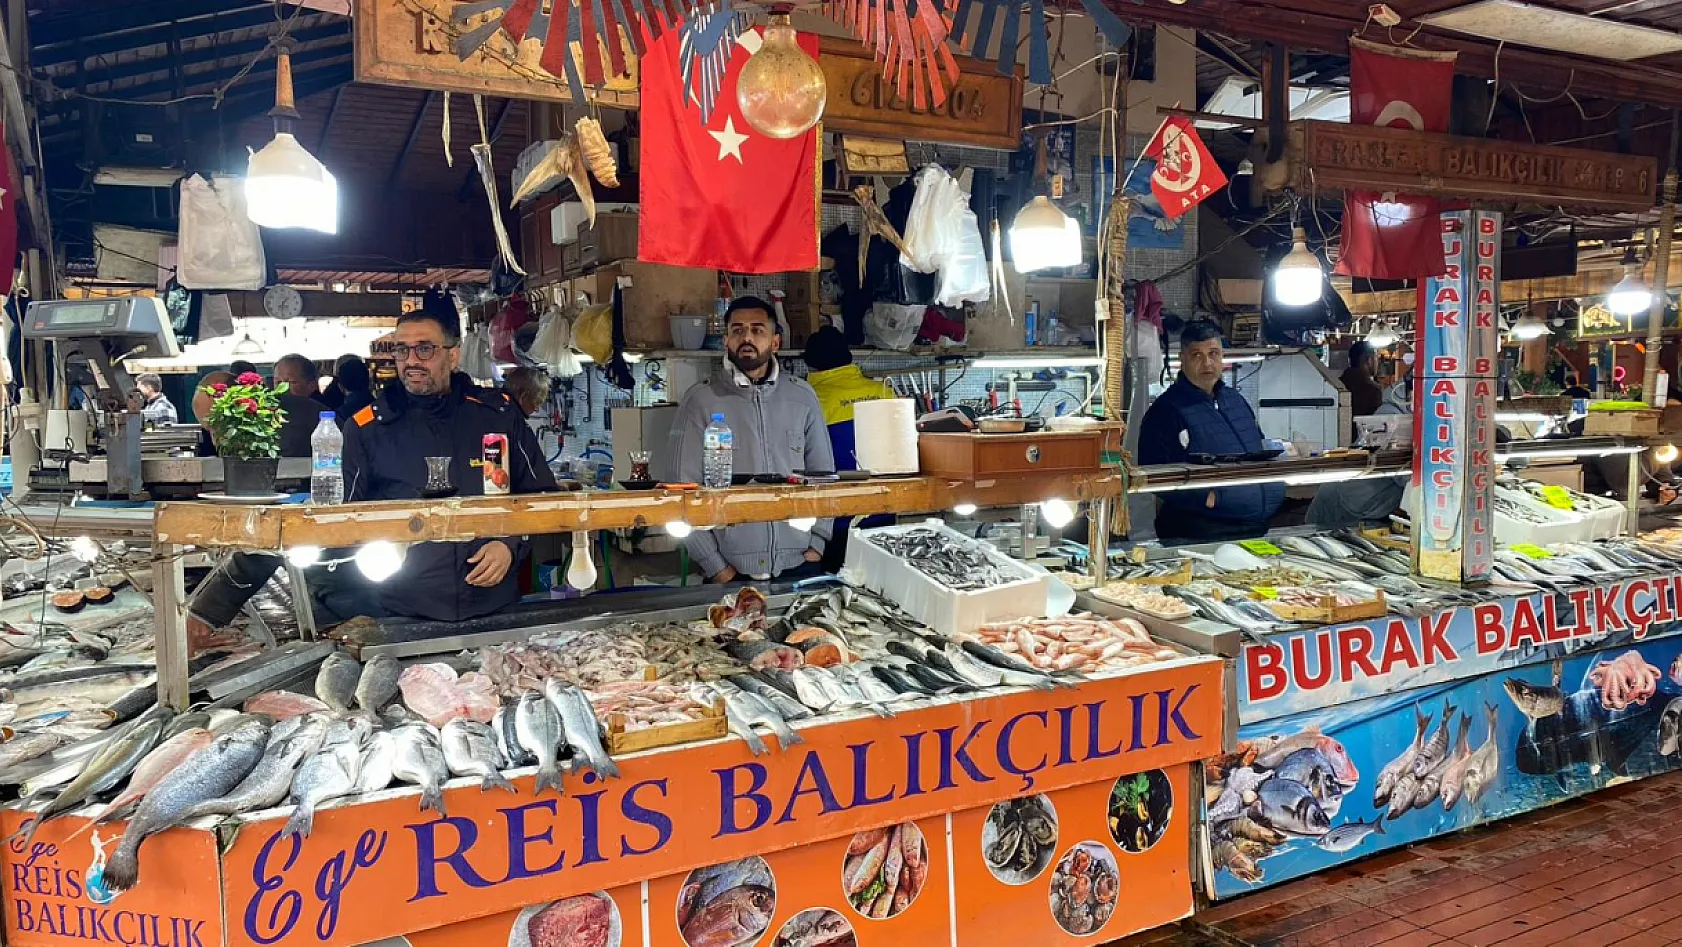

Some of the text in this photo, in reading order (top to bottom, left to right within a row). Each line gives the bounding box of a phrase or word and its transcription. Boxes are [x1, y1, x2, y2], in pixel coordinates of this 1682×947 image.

[1181, 184, 1211, 208] ATA
[1475, 218, 1496, 328] BURAK
[1246, 610, 1459, 703] BURAK
[710, 683, 1203, 838] BALIKÇILIK
[10, 860, 82, 899] REİS
[244, 772, 673, 945] Ege REİS
[14, 898, 206, 947] BALIKÇILIK
